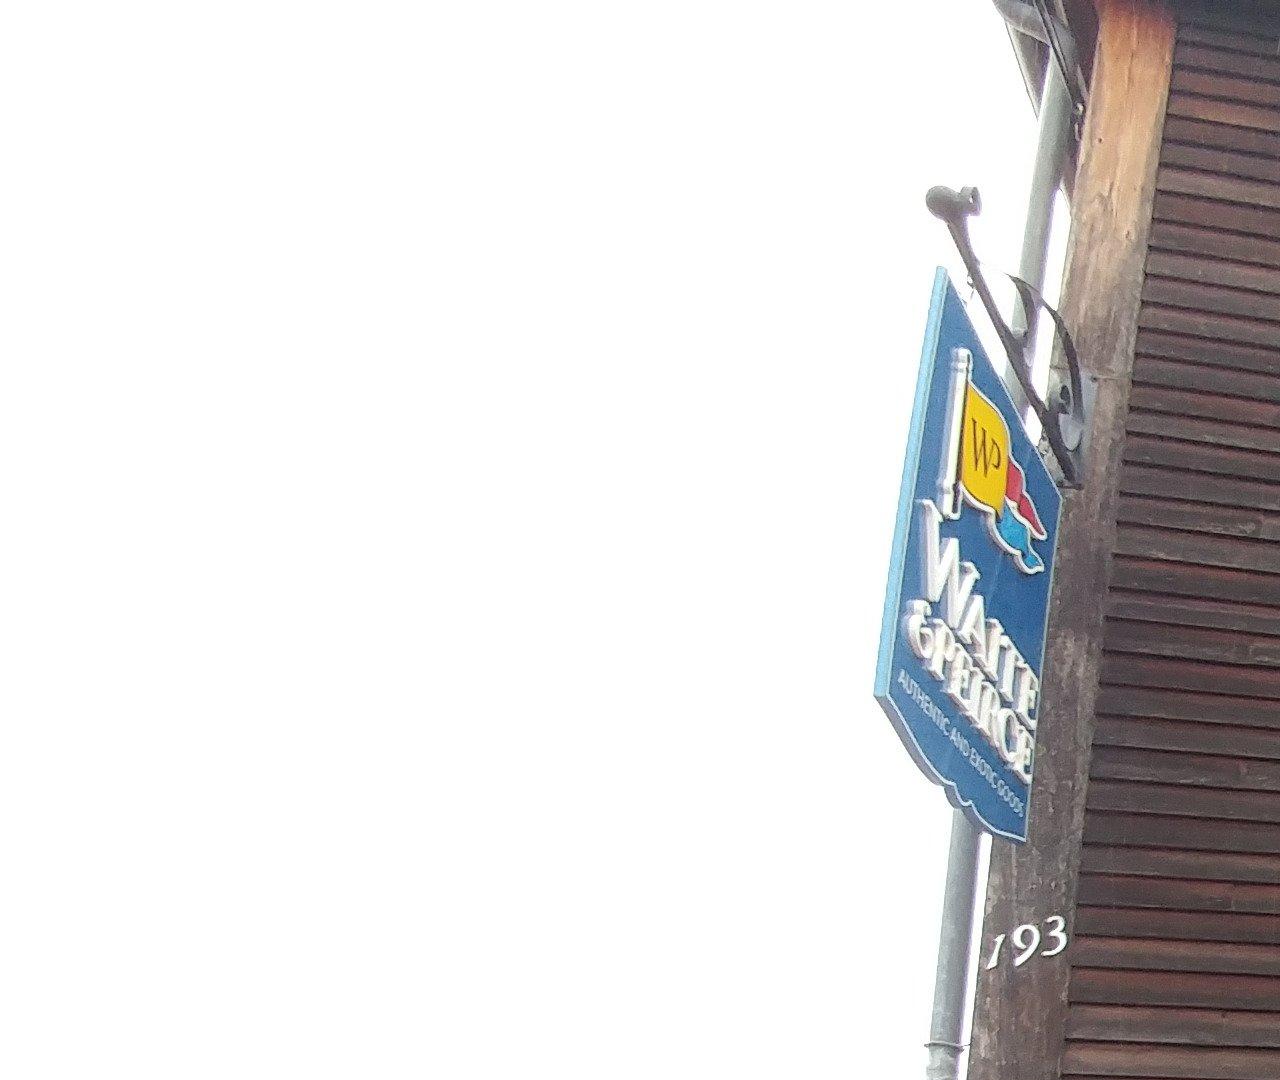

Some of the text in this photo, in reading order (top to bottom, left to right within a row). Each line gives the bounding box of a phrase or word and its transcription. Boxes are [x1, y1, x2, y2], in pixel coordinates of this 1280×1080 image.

[917, 499, 1040, 731] WAITE
[897, 669, 1024, 817] AUTHENTIC AND EXOTIC GOODS
[984, 915, 1067, 970] 193
